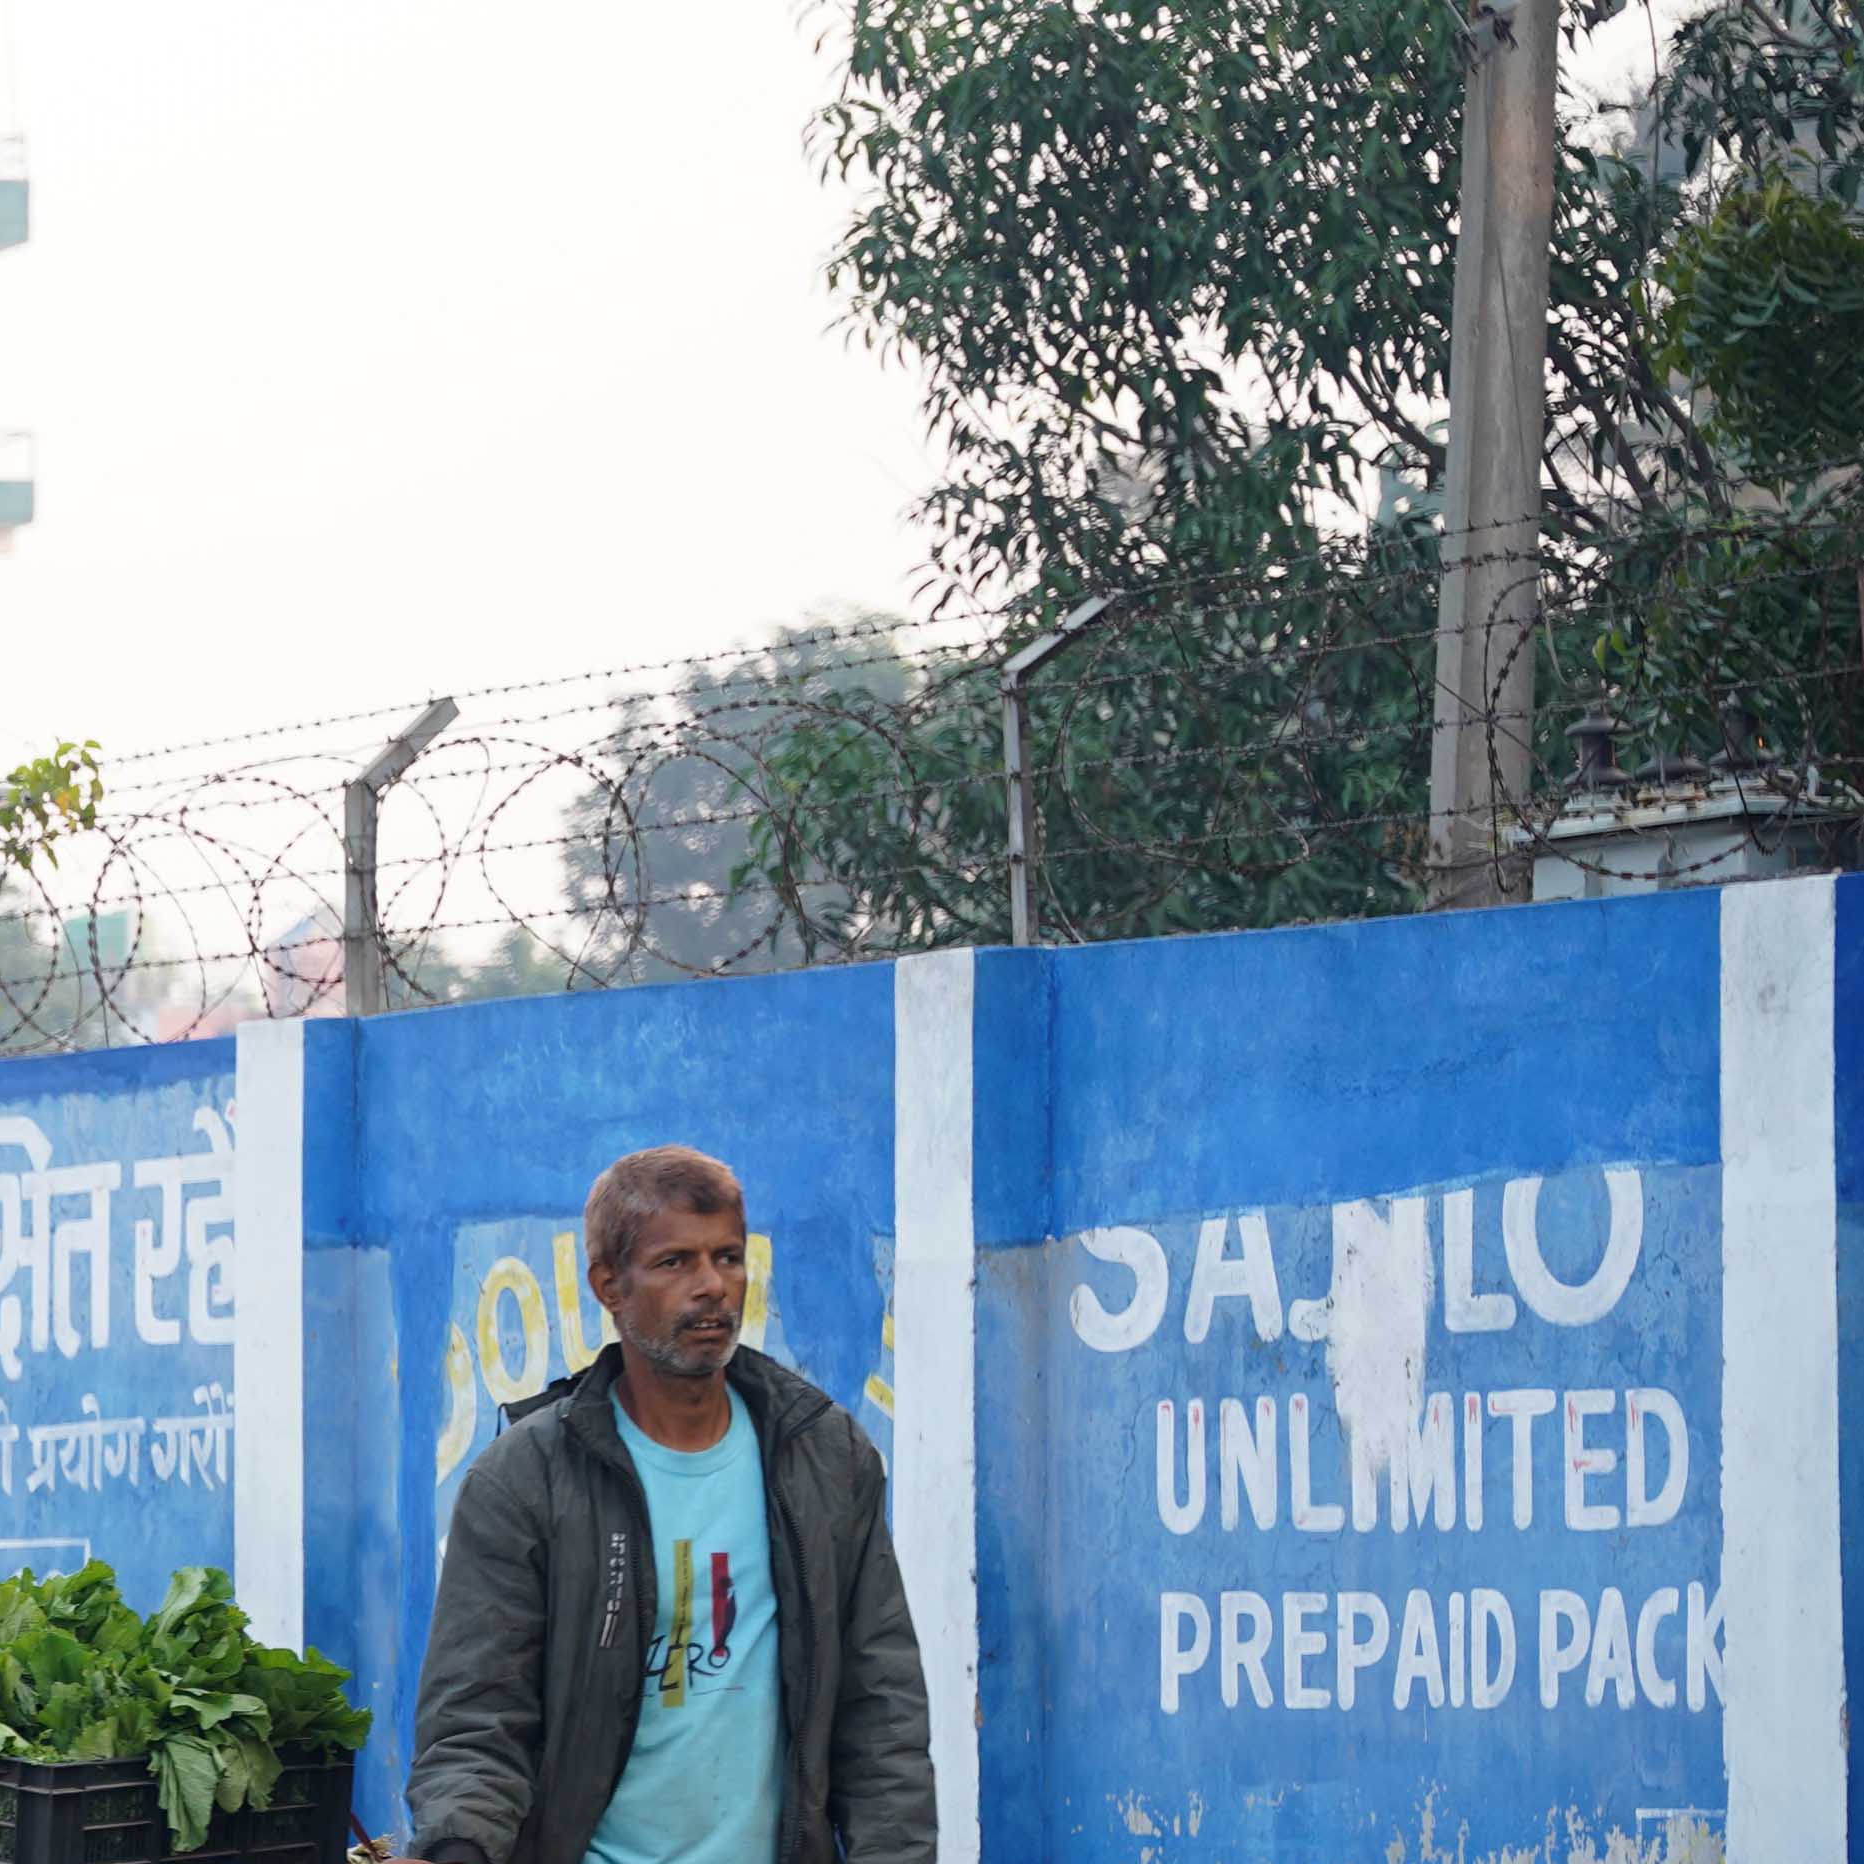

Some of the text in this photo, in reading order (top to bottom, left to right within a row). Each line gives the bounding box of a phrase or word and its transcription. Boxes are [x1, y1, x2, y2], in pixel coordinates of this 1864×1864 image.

[27, 1393, 145, 1494] प्रयोग
[1157, 1388, 1690, 1534] UNLIMITED
[1160, 1581, 1727, 1715] PREPAID PACK
